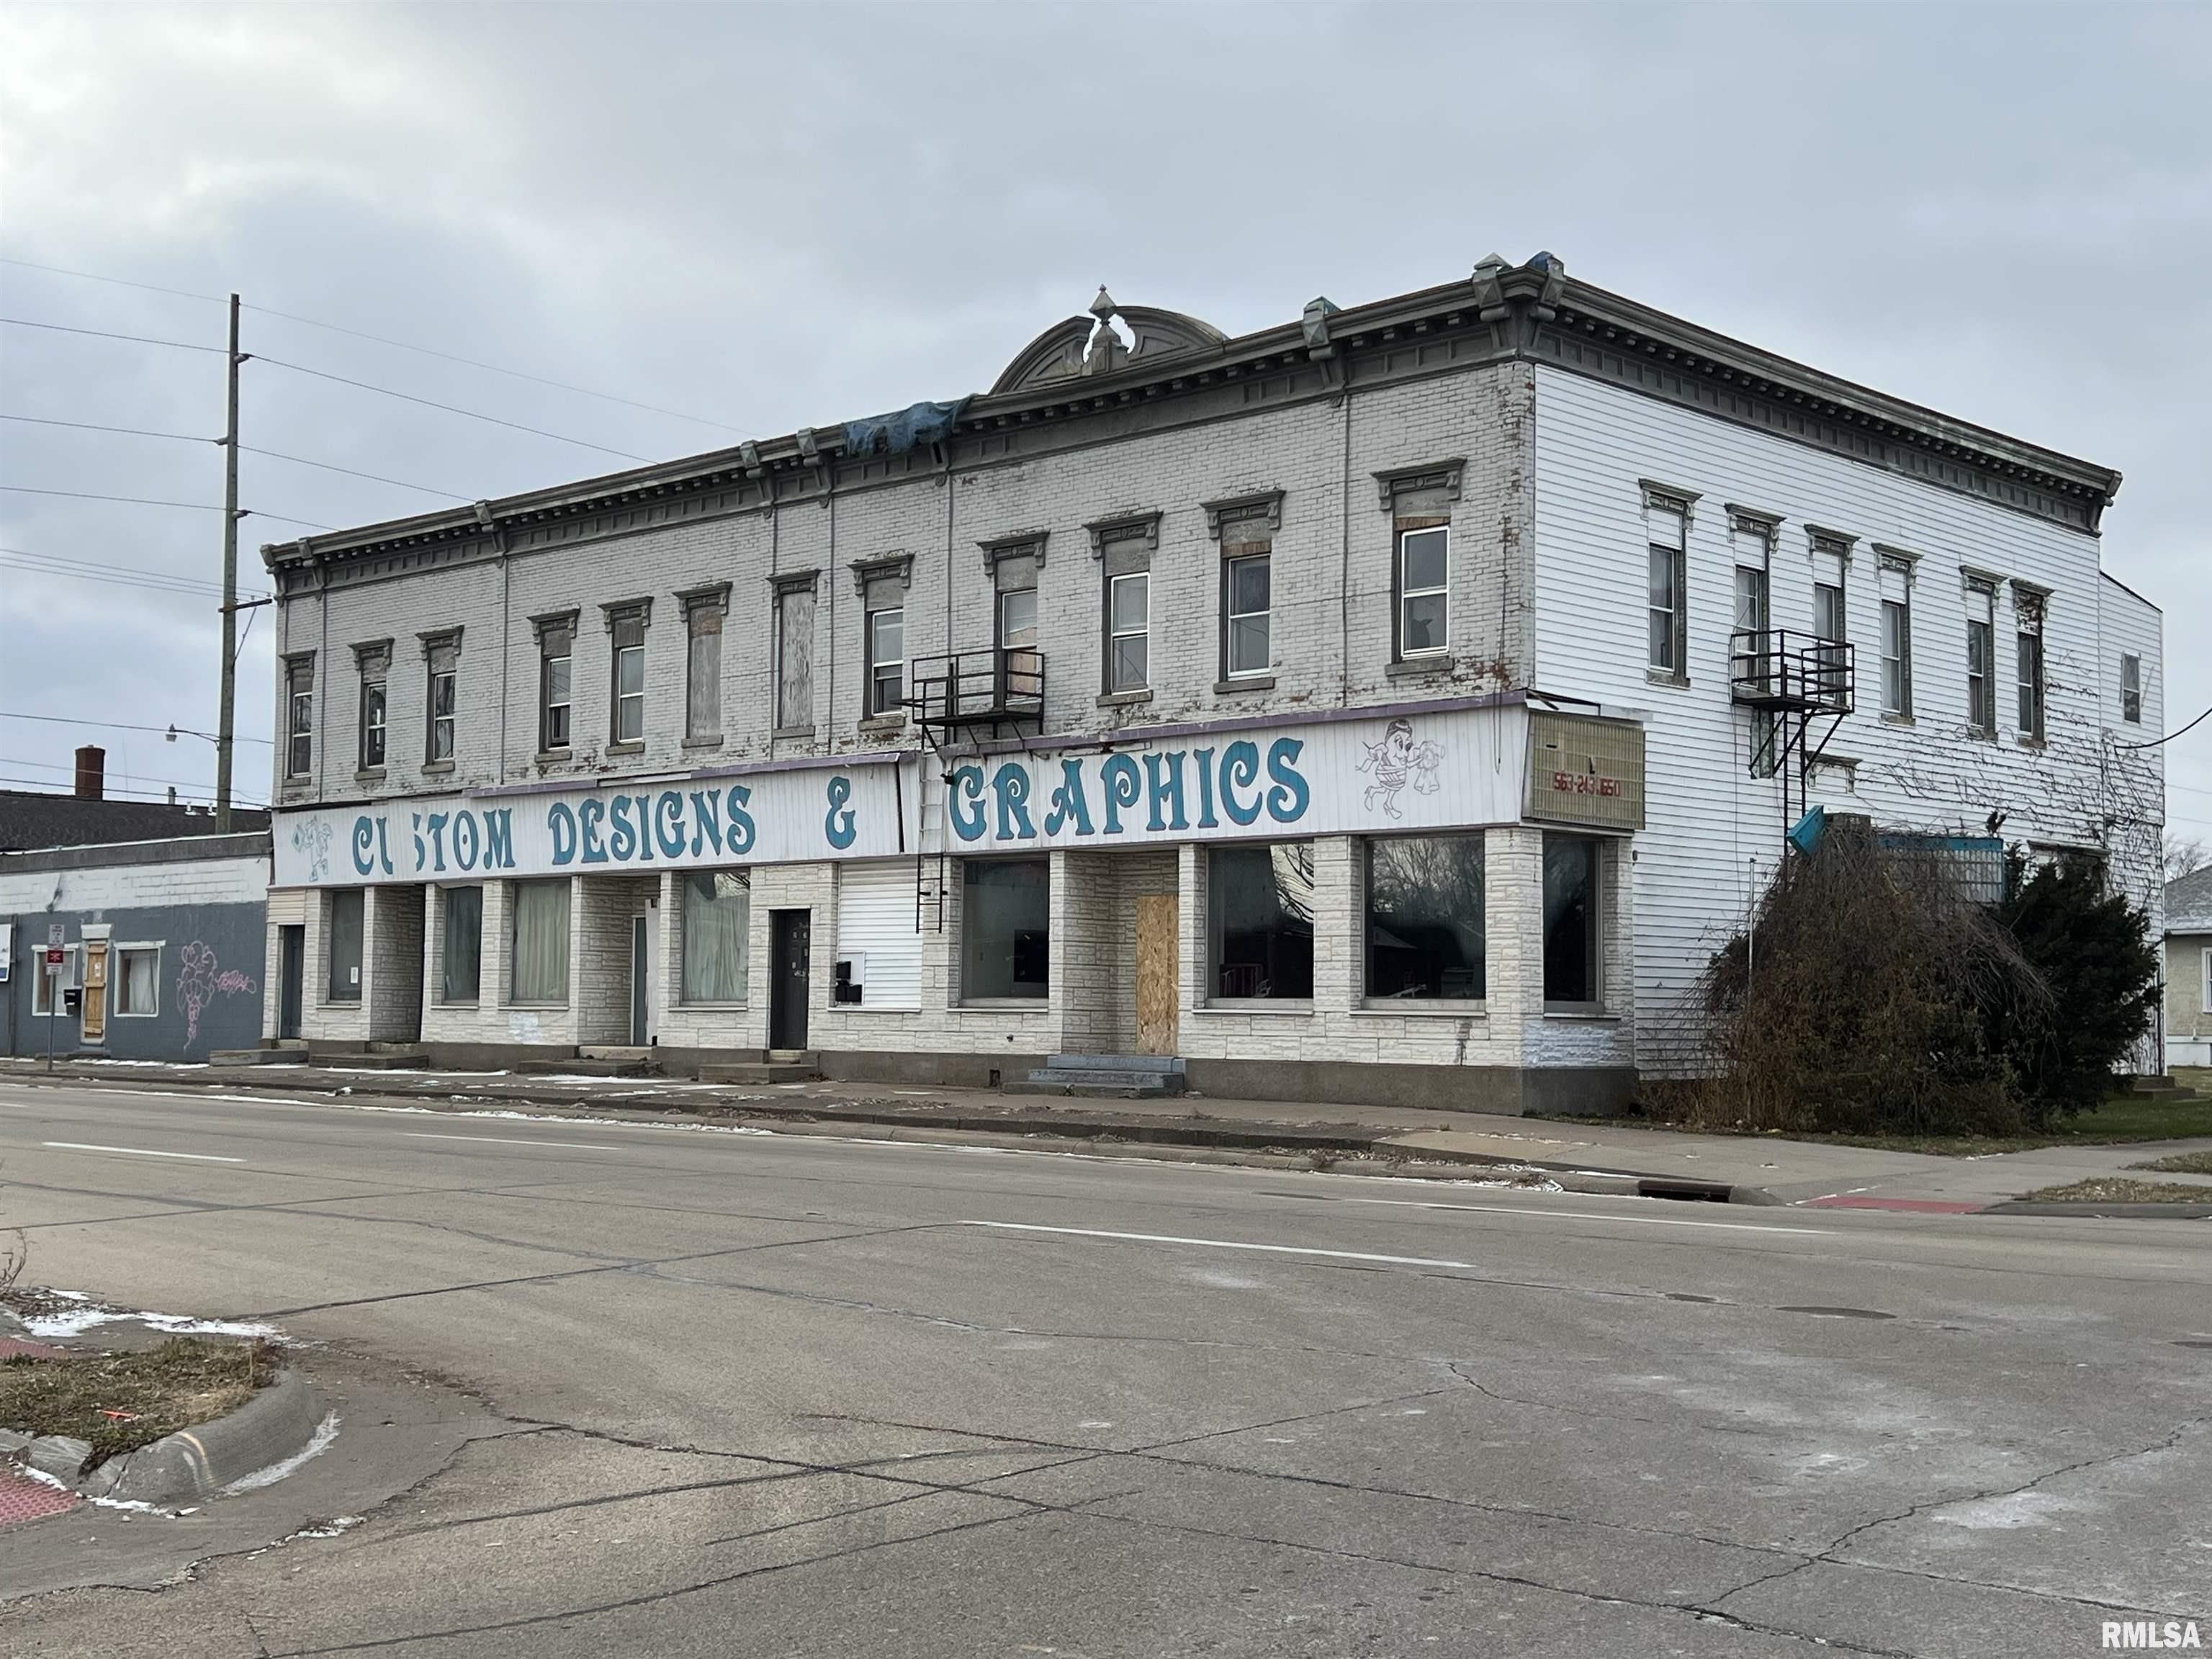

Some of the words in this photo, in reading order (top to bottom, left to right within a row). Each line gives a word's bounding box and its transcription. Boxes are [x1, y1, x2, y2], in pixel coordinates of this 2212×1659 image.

[548, 785, 756, 866] DESIGNS
[825, 775, 857, 850] &
[949, 737, 1310, 842] GRAPHICS
